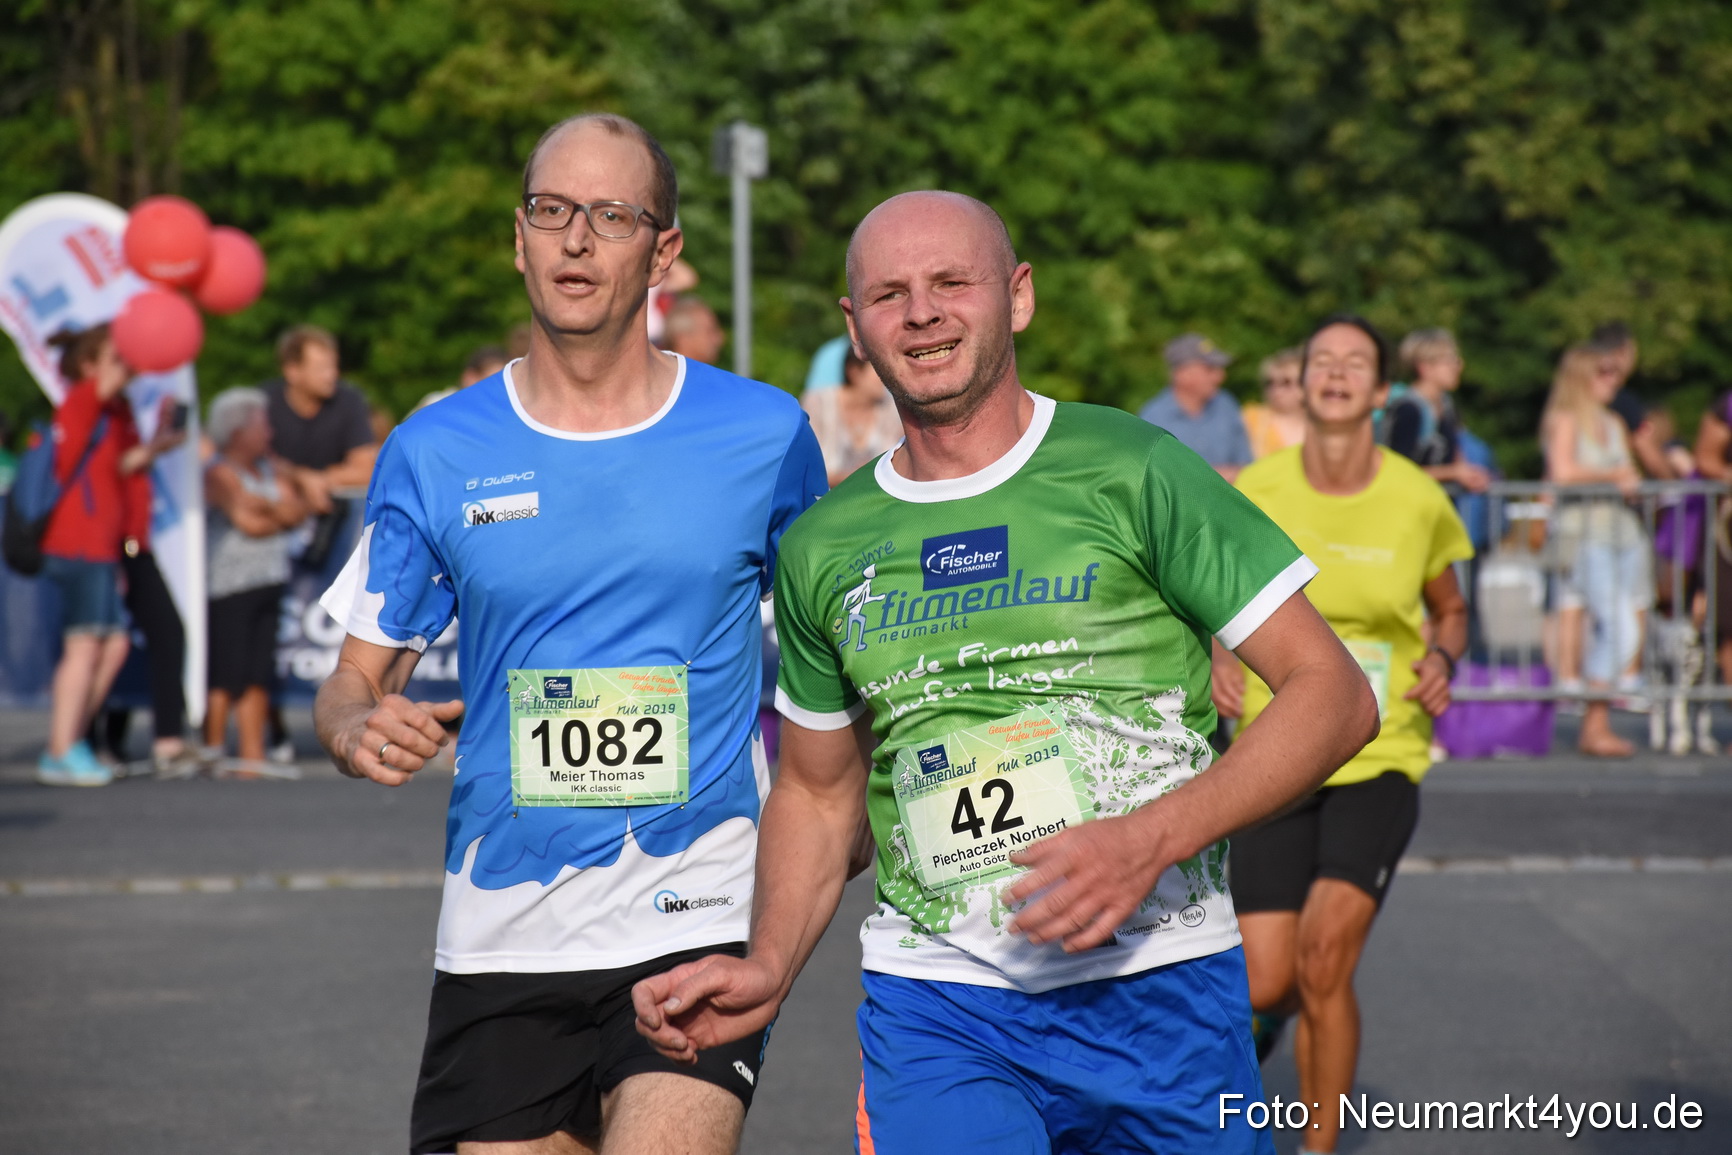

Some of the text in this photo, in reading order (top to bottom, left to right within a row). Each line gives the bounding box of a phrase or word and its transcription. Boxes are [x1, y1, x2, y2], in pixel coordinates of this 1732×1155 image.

[496, 506, 539, 523] classic
[940, 550, 1002, 569] Fischer
[947, 562, 997, 576] AUTOMOBILE
[880, 562, 1100, 628] firmenlauf
[878, 616, 969, 643] neumarkt
[958, 637, 1079, 668] Firmen
[885, 652, 1096, 721] laufen länger!
[533, 695, 600, 709] firmenlauf
[643, 703, 675, 715] 2019
[531, 717, 664, 767] 1082
[1024, 745, 1060, 767] 2019
[550, 770, 645, 782] Meier Thomas
[913, 756, 977, 790] firmenlauf
[571, 784, 622, 793] IKK classic
[951, 778, 1025, 840] 42
[933, 817, 1068, 869] Piechaczek Norbert
[960, 861, 982, 874] Auto
[983, 853, 1007, 868] Götz
[690, 894, 735, 910] classic
[1117, 922, 1161, 938] Frischmann
